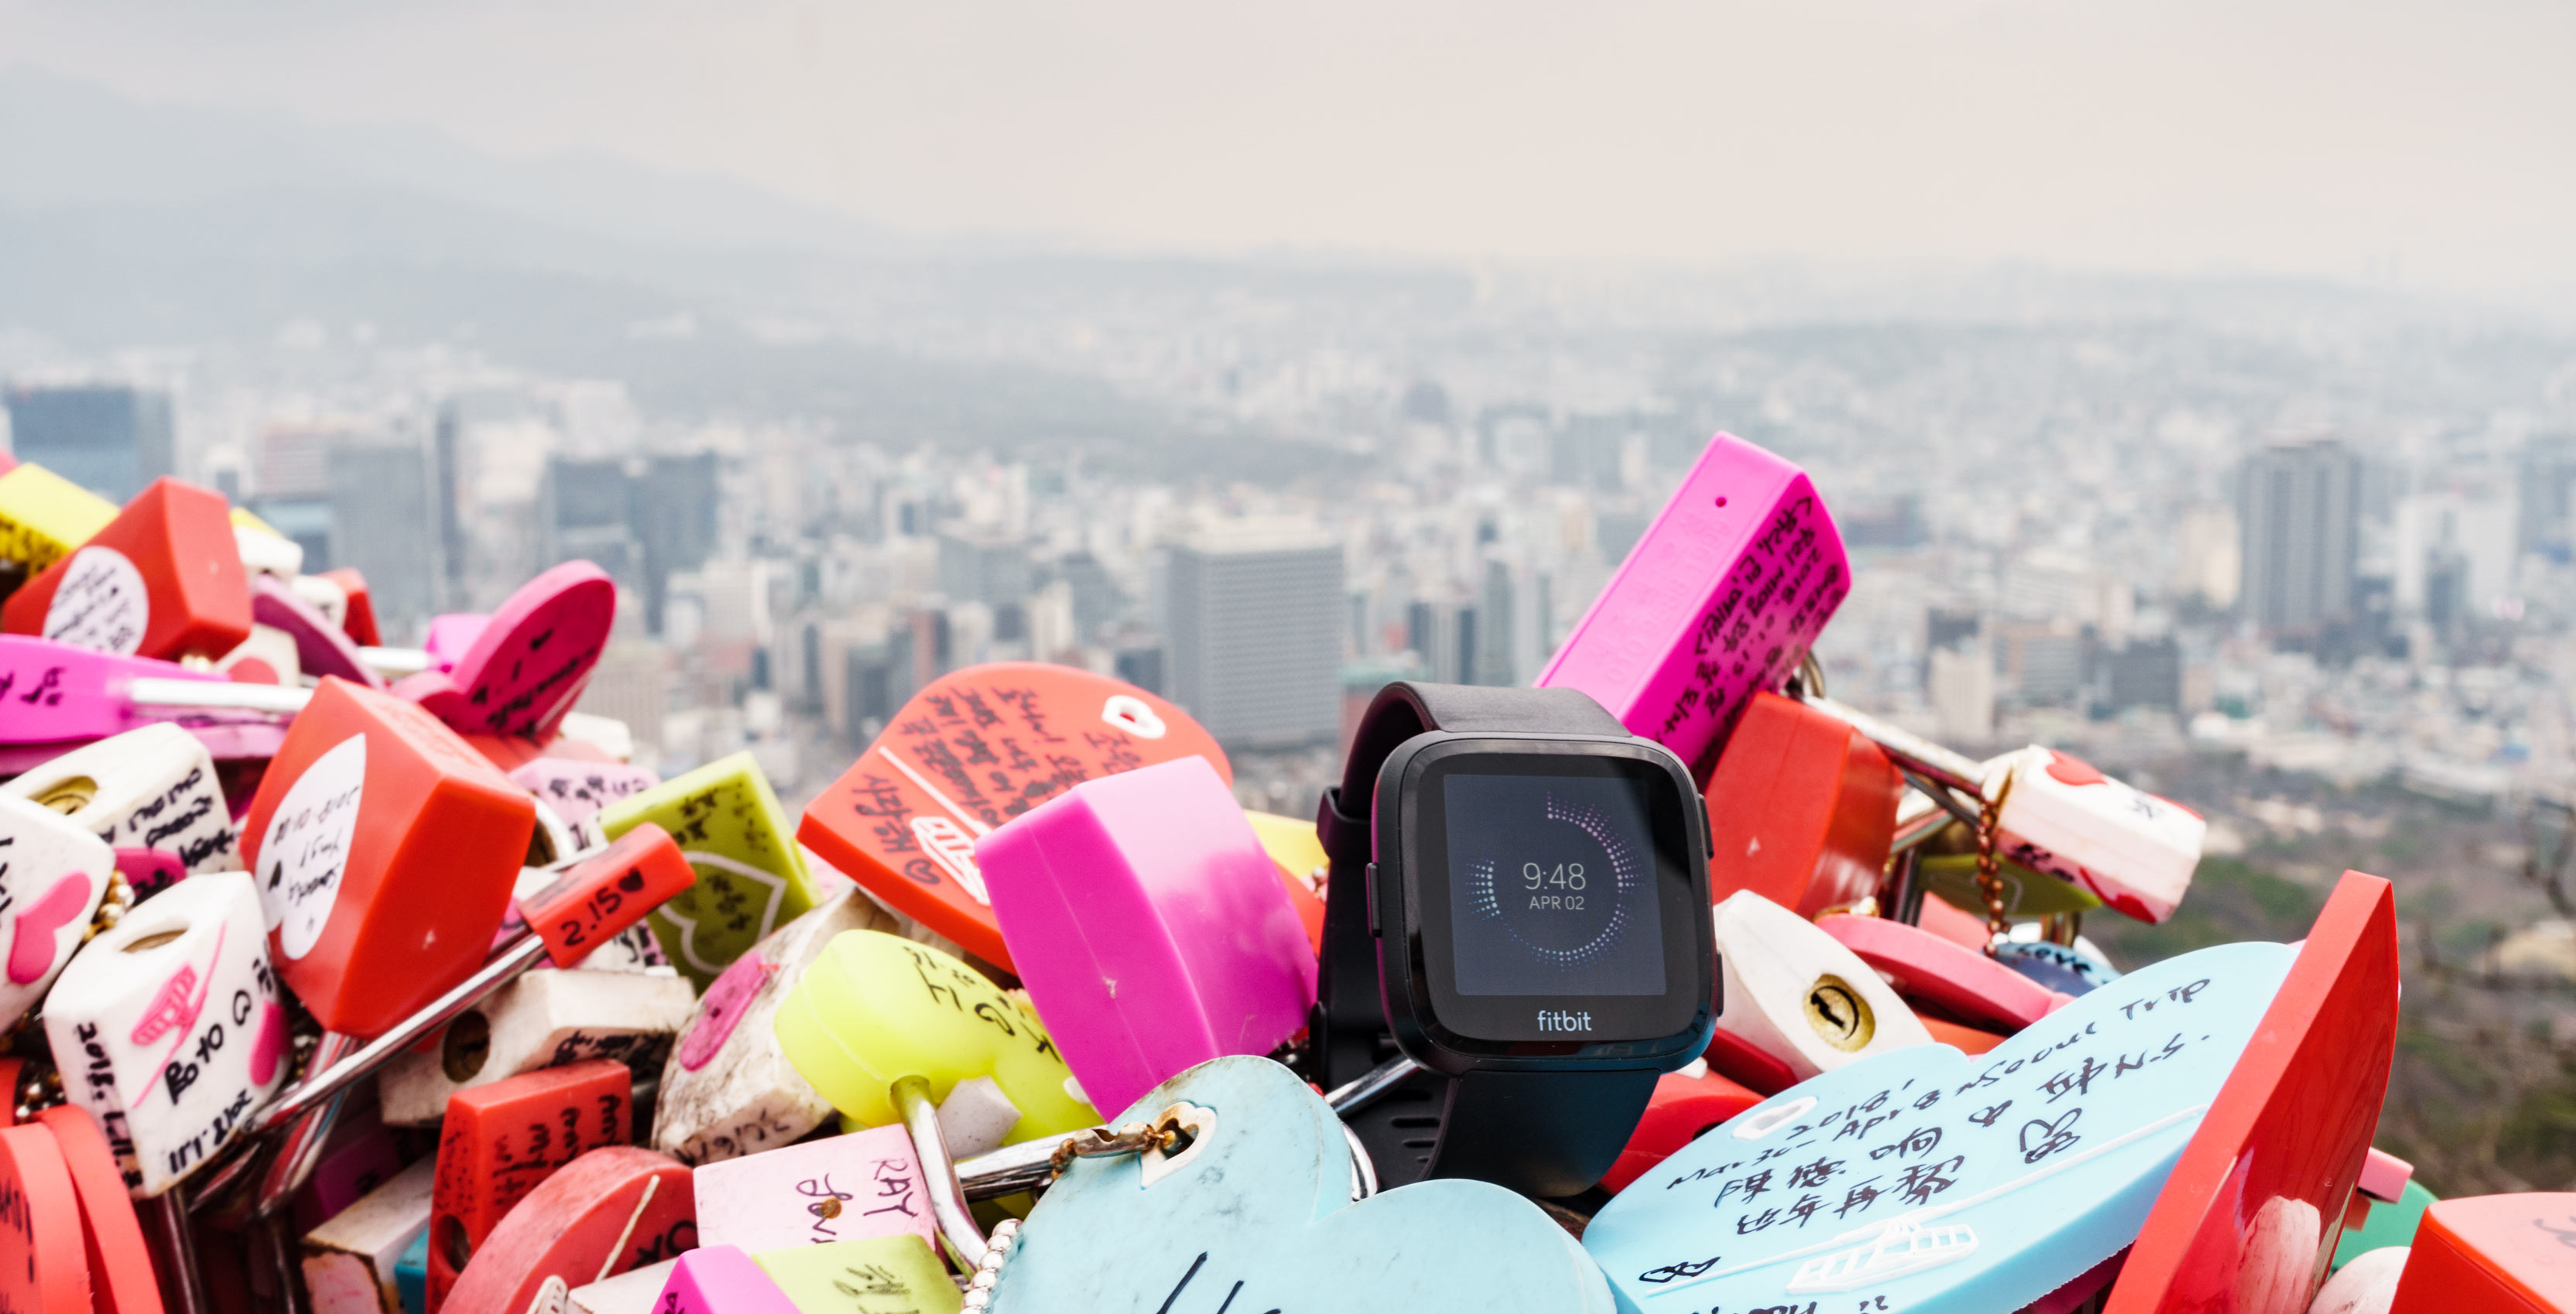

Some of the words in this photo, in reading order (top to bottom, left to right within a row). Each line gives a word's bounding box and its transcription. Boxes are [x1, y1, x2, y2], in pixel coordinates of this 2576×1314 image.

[1523, 862, 1586, 891] 9:48
[561, 887, 622, 946] 2.15
[1529, 895, 1561, 910] APR
[1564, 895, 1585, 910] 02
[1536, 1010, 1592, 1032] fitbit
[1832, 1107, 1903, 1141] Apr
[2119, 978, 2211, 1021] Trip
[862, 1158, 919, 1220] RAY
